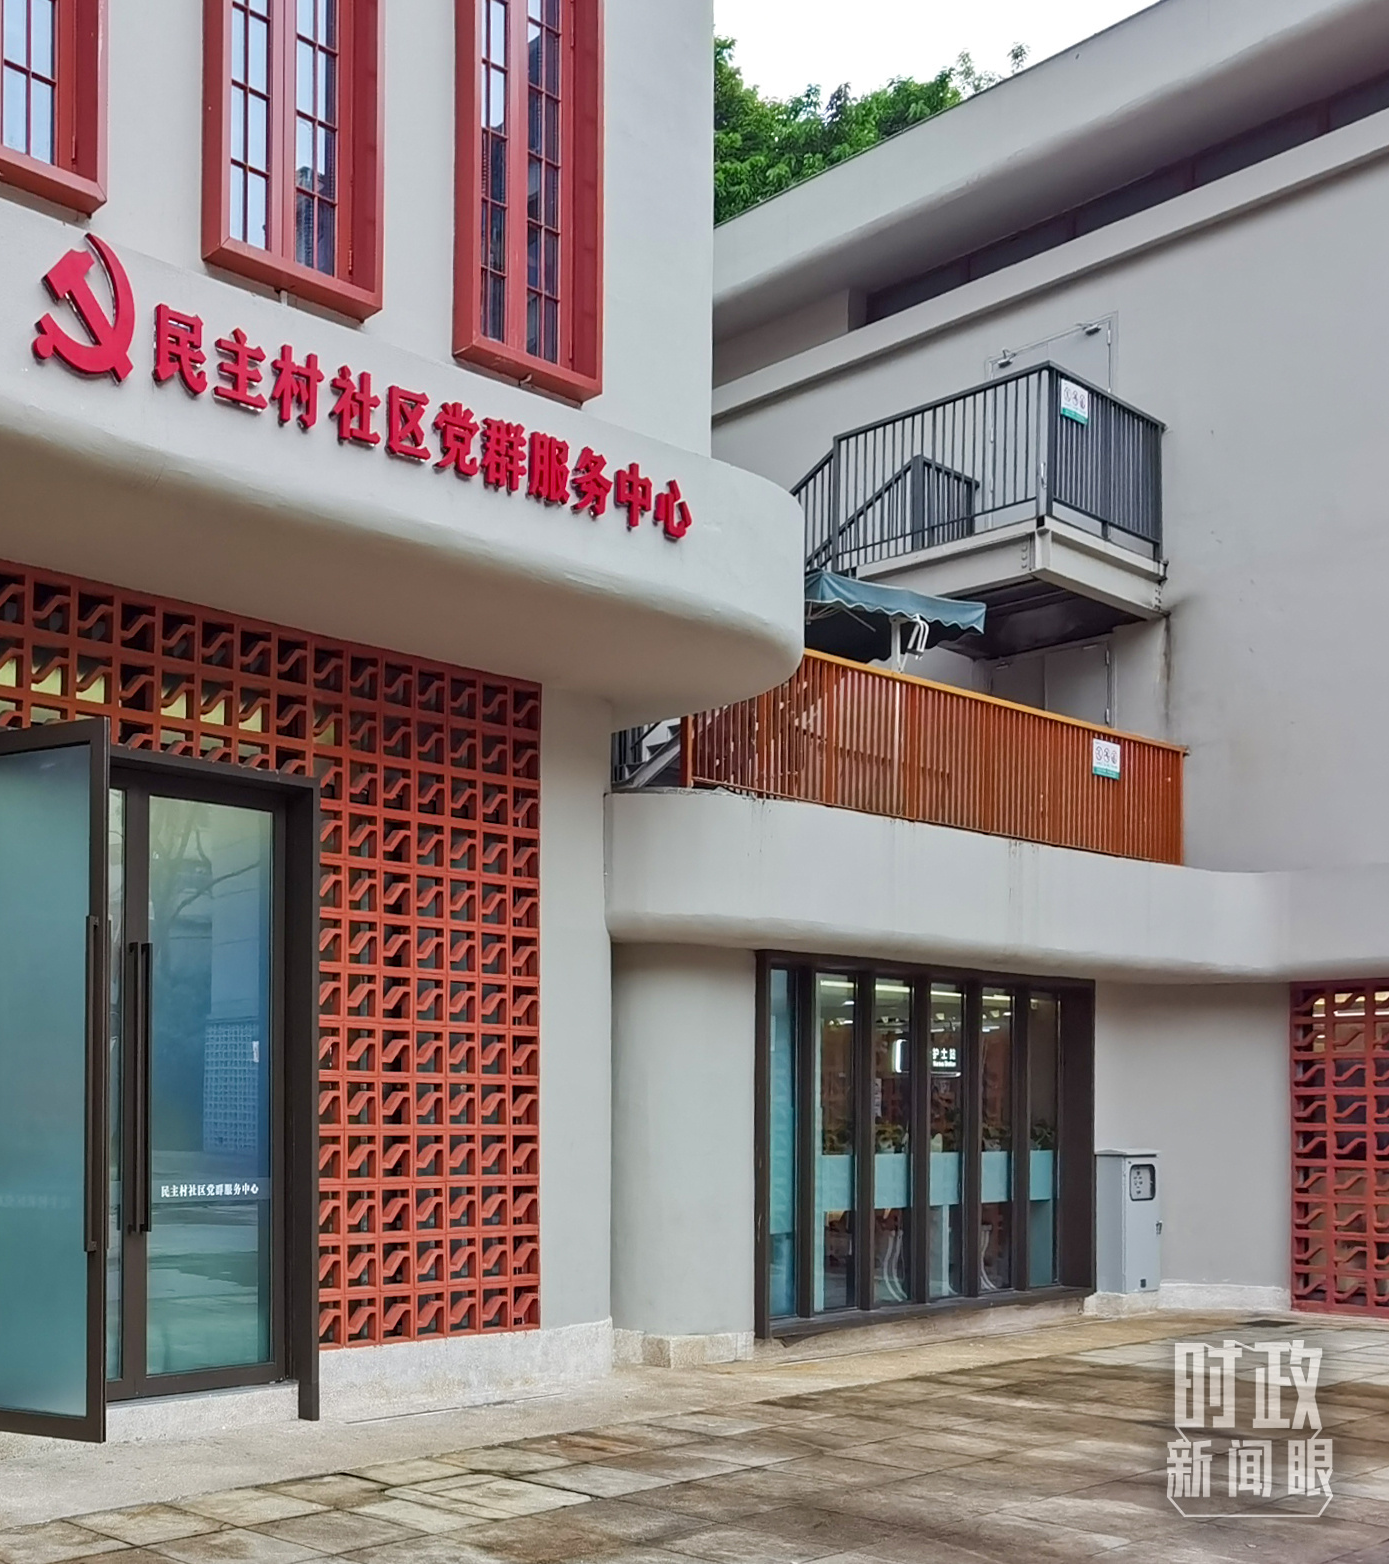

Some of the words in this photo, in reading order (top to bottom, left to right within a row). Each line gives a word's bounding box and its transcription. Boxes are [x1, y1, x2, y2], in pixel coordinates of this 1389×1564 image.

[153, 302, 692, 541] 民主村社区党群服务中心
[160, 1183, 259, 1198] 民主村社区党群服务中心
